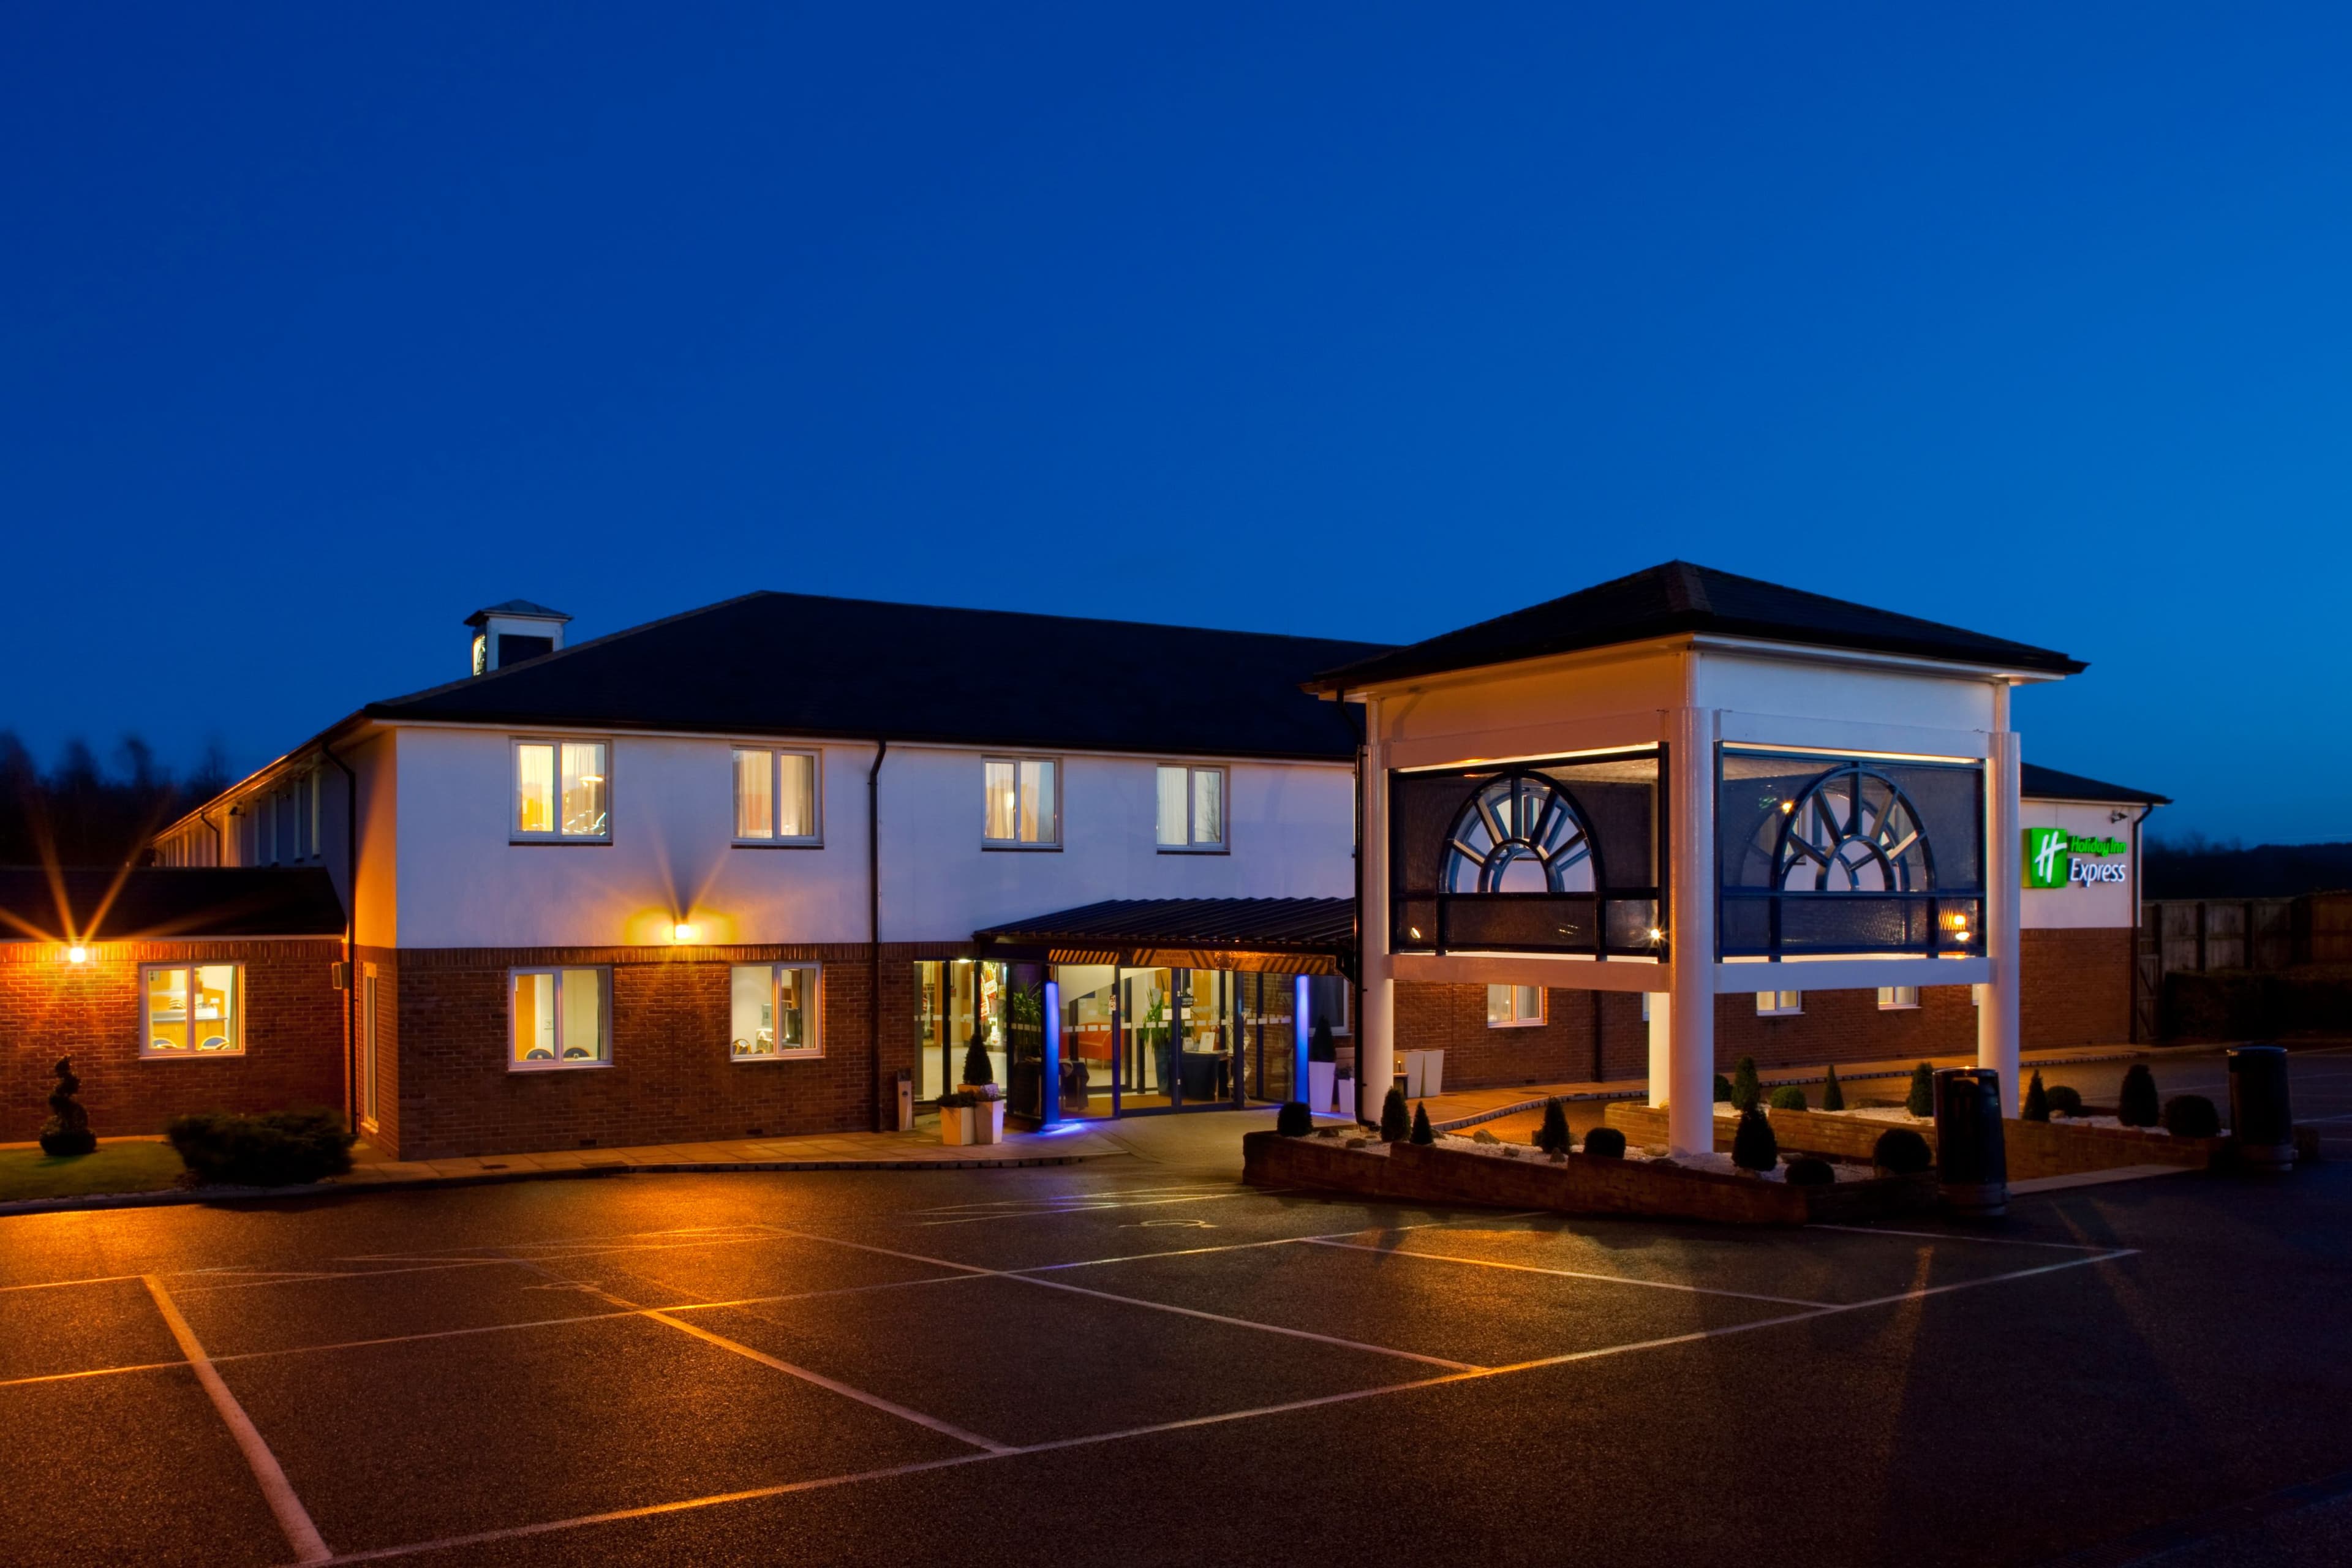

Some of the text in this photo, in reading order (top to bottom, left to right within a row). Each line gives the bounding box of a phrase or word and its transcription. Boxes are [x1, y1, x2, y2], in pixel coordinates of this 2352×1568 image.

[2071, 835, 2126, 857] Holiday Inn
[2070, 858, 2126, 887] Express
